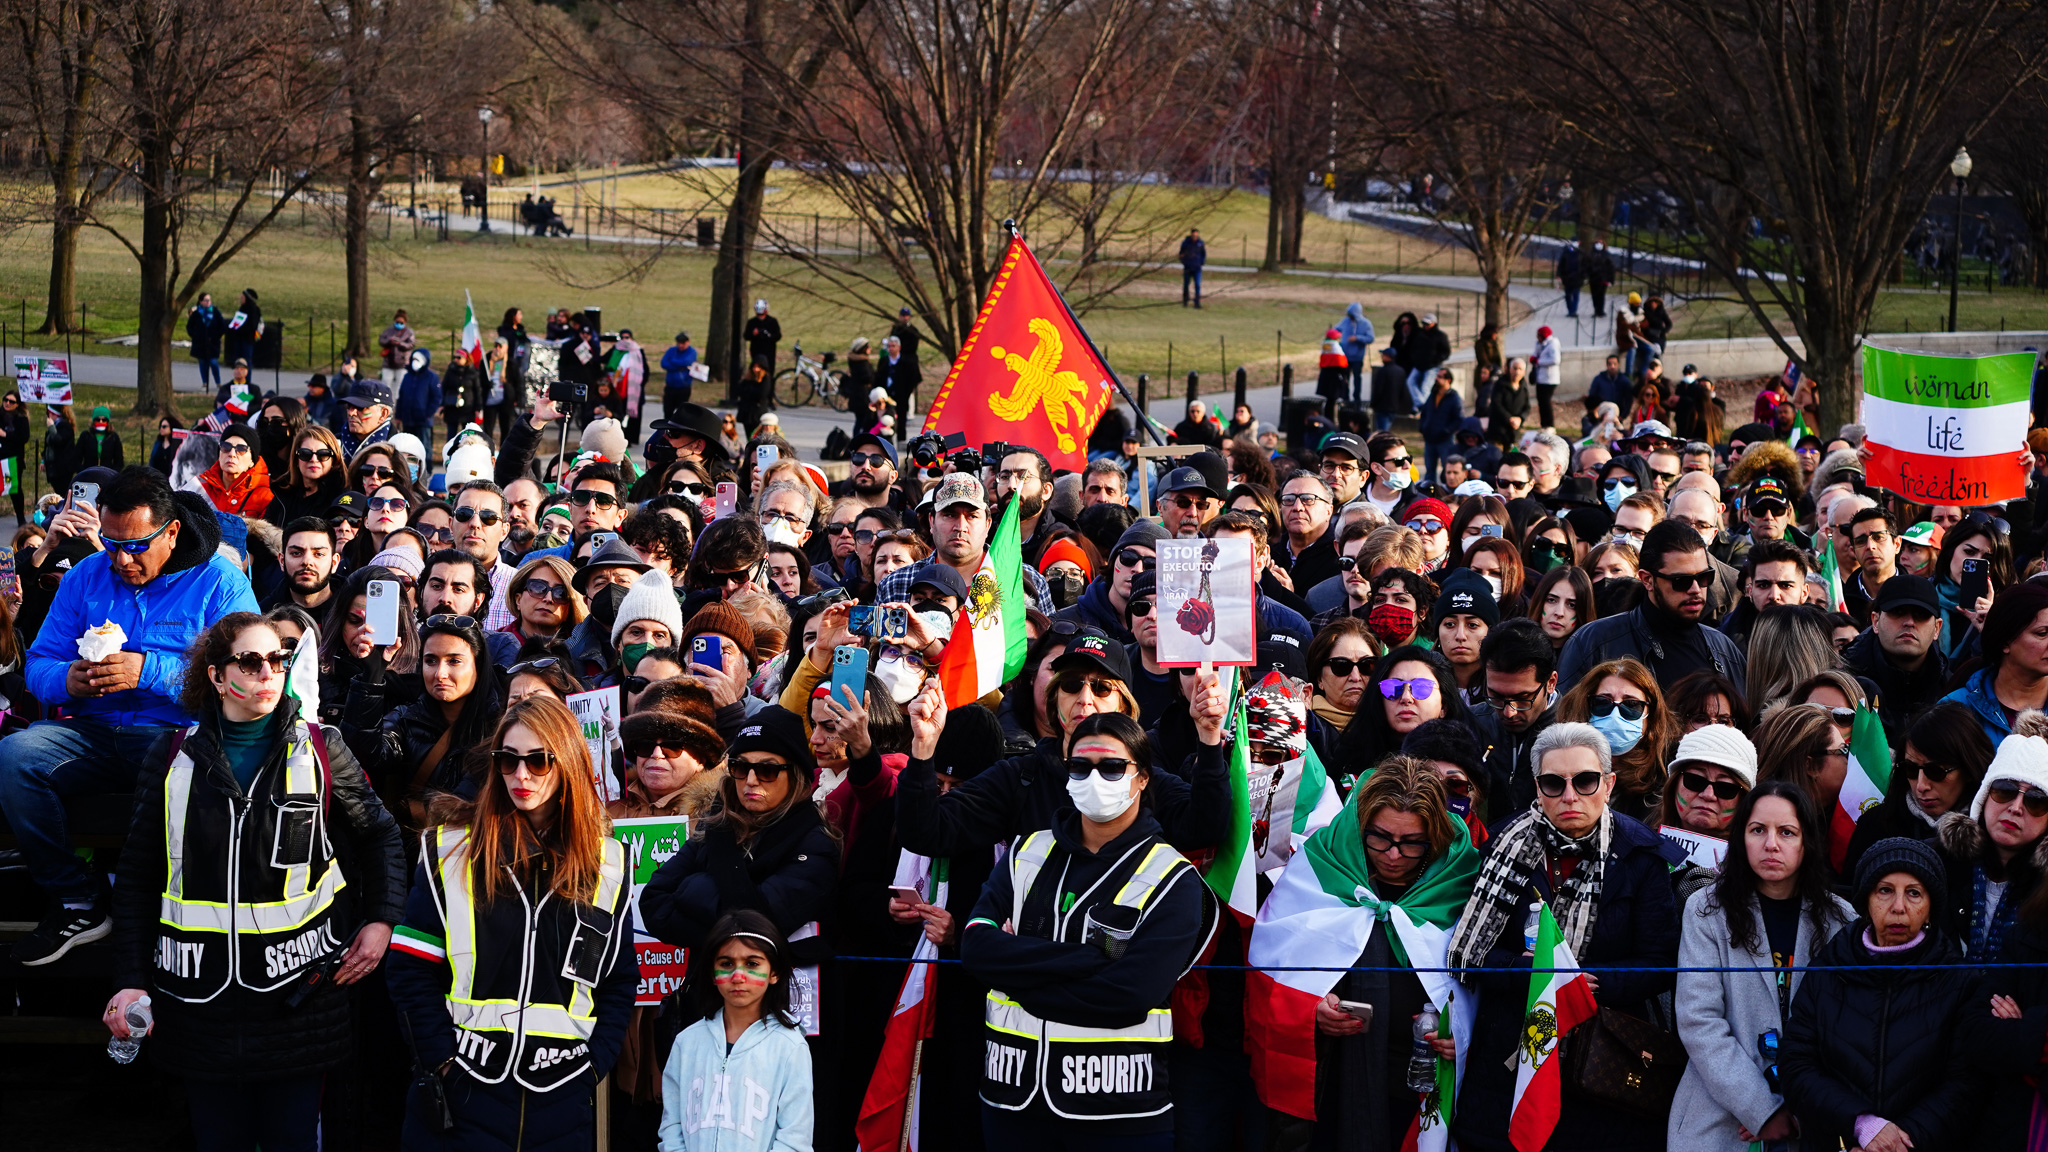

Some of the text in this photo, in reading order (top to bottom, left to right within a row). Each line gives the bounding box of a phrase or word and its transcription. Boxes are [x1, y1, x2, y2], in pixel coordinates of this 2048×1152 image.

[1163, 546, 1203, 560] STOP
[1162, 562, 1221, 572] EXECUTION
[1162, 573, 1174, 582] IN
[1166, 592, 1188, 600] IRAN
[583, 721, 600, 740] AN
[1248, 773, 1274, 791] STOP
[1249, 782, 1283, 800] XECUTION
[153, 934, 205, 979] CURITY
[644, 949, 672, 965] Cause
[674, 948, 685, 964] Of
[636, 972, 682, 995] erty
[1061, 1053, 1153, 1094] SECURITY
[685, 1073, 771, 1141] GAP
